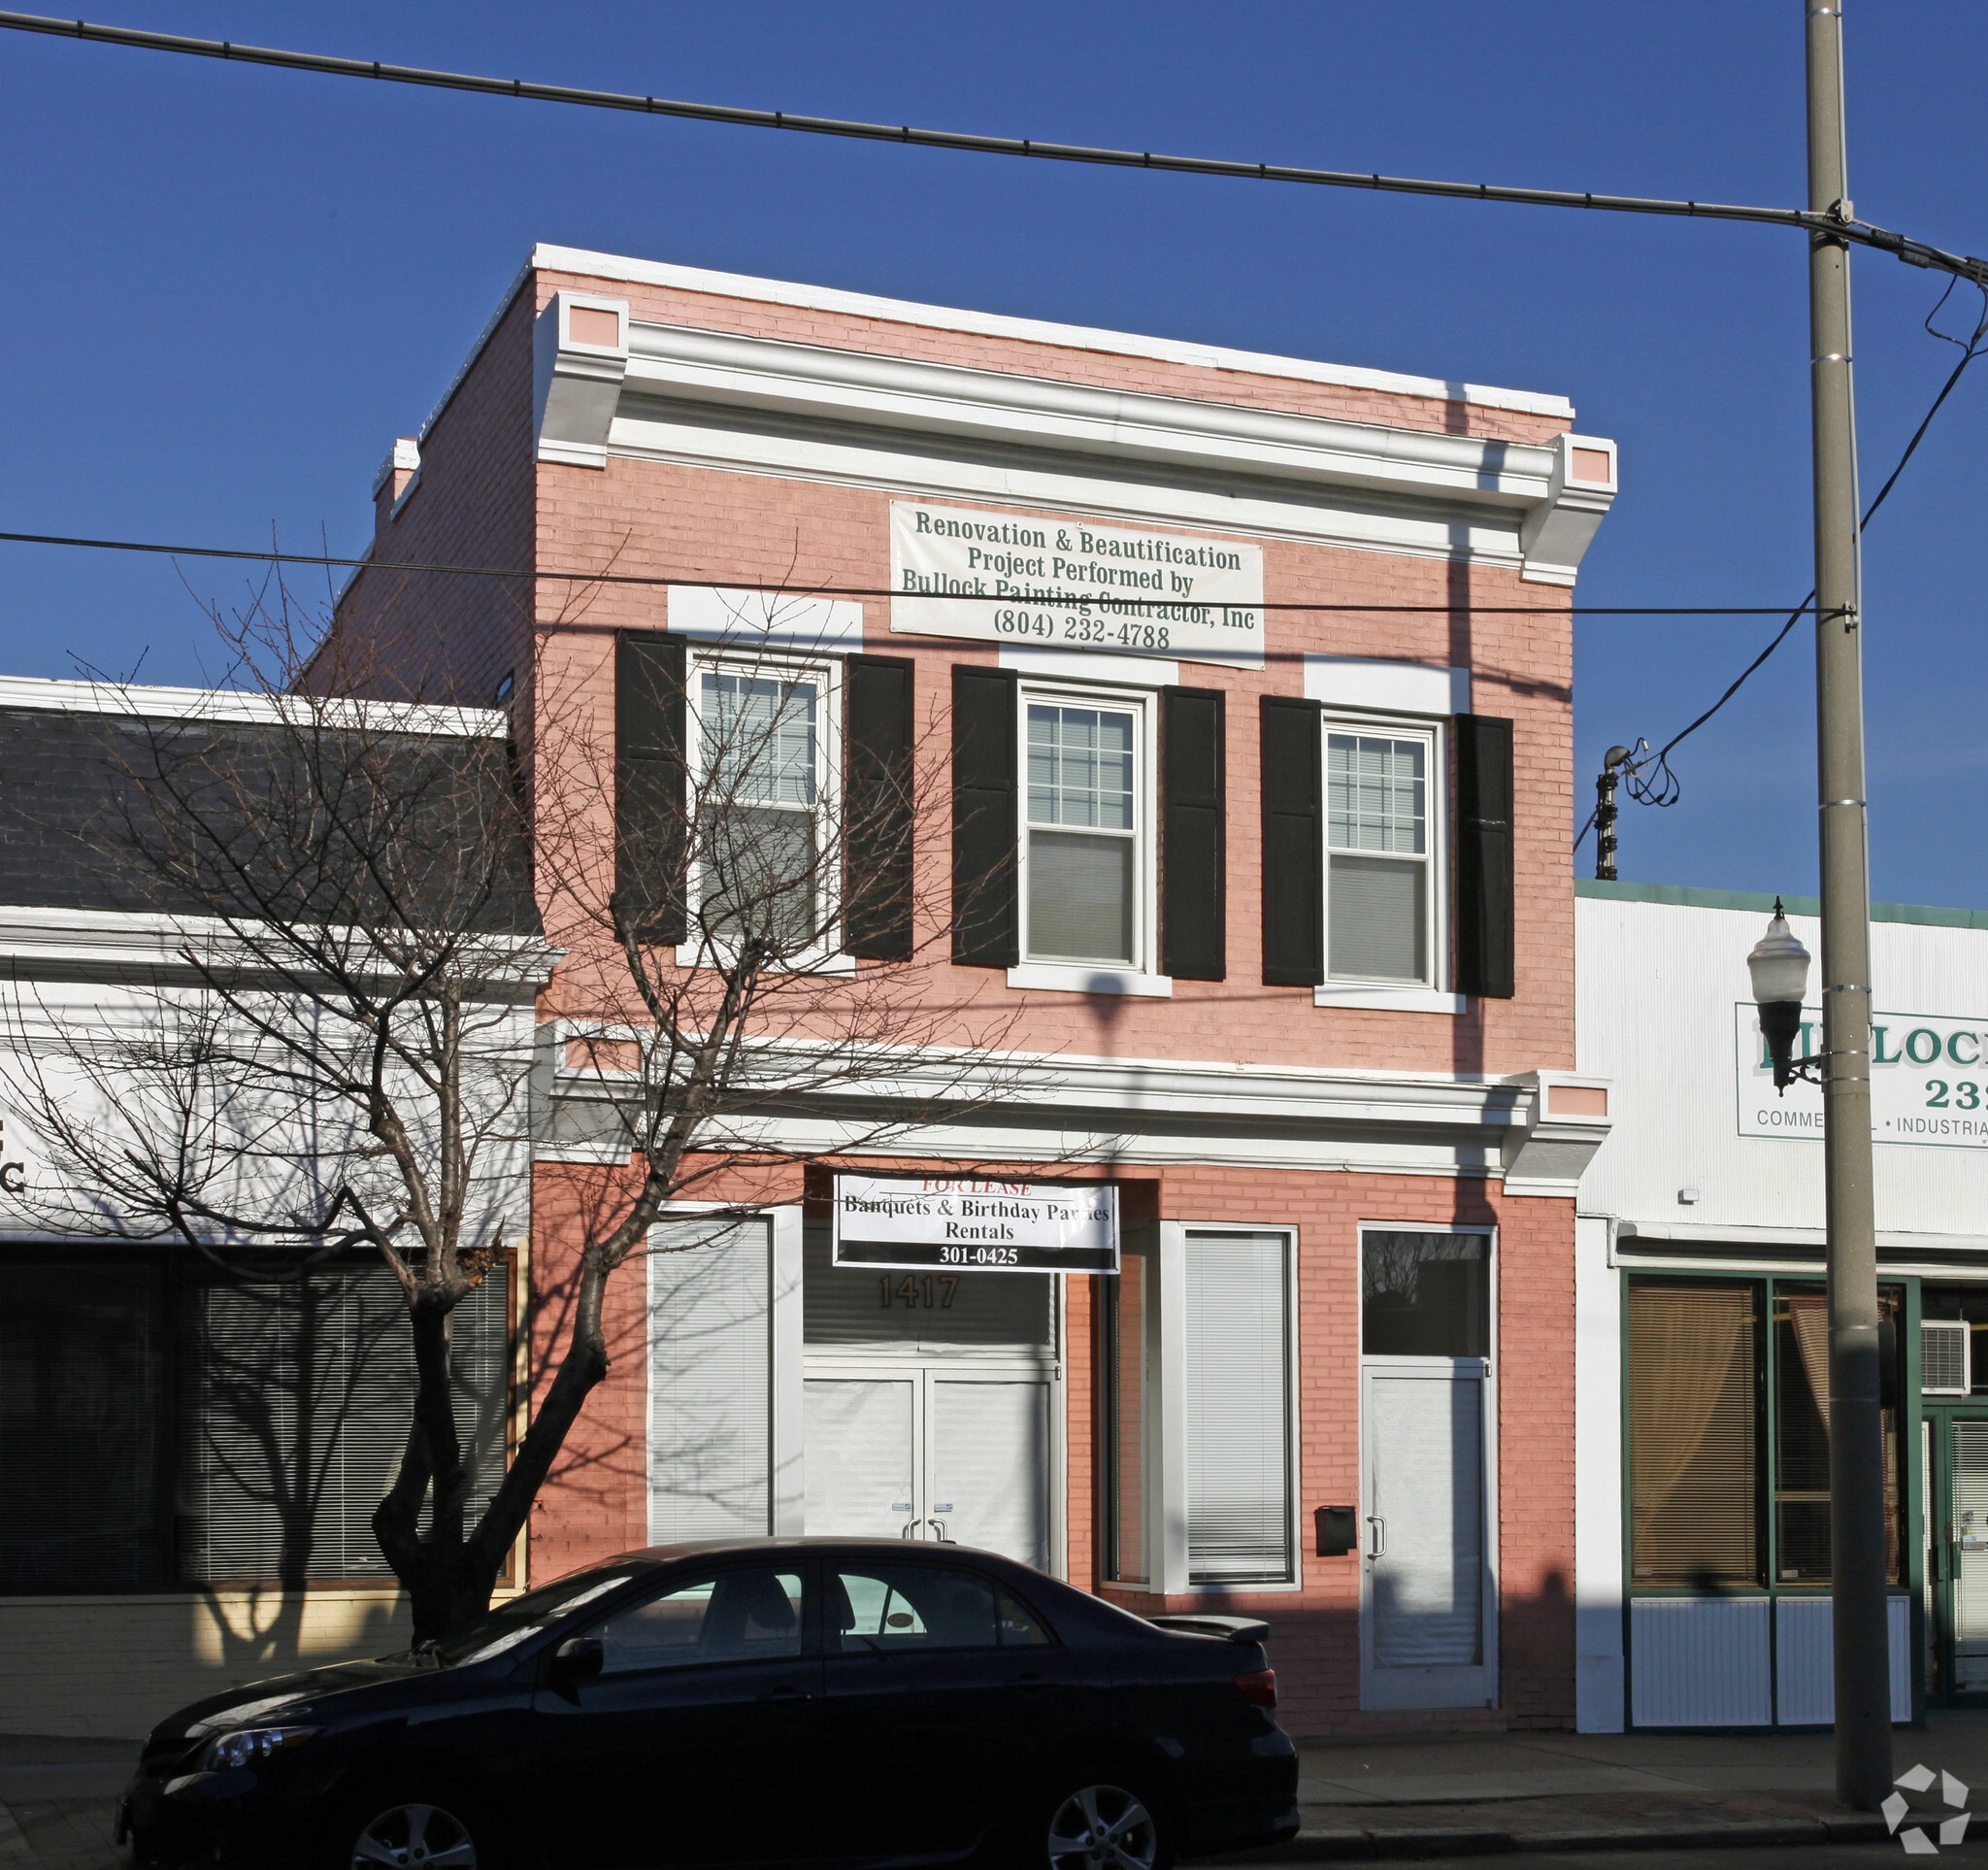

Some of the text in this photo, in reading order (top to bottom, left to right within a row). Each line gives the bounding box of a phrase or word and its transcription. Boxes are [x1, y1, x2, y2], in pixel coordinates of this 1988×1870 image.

[915, 511, 1242, 570] Renovation & Beautification
[968, 547, 1194, 598] Project Performed by
[903, 568, 1255, 630] Bullock Painting Contractor, Inc
[994, 609, 1170, 650] (804) 232-4788
[1925, 1080, 1988, 1111] 23
[922, 1180, 1032, 1196] FOR LEASE
[845, 1195, 931, 1218] Banquets
[937, 1199, 953, 1216] &
[962, 1199, 1041, 1223] Birthday
[945, 1221, 1014, 1240] Rentals
[940, 1247, 1018, 1264] 301-0425
[879, 1274, 960, 1308] 1417
